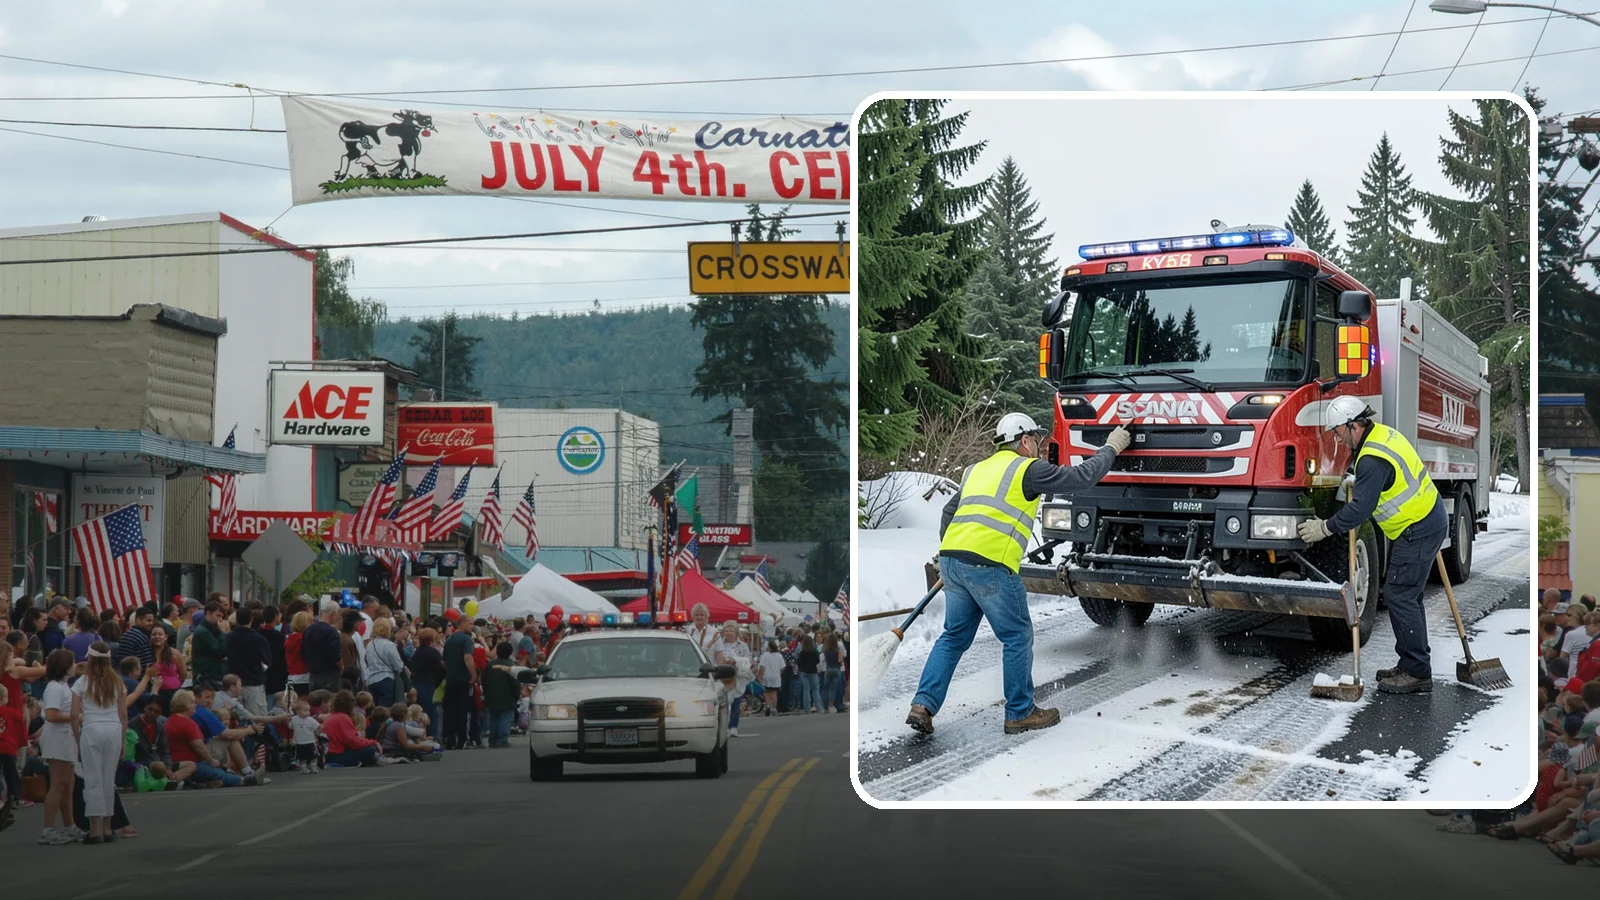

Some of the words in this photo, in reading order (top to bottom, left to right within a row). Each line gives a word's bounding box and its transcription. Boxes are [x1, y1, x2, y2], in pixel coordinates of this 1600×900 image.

[481, 141, 604, 192] JULY
[632, 149, 746, 197] 4th.
[697, 254, 850, 280] CROSSWA
[283, 380, 373, 420] ACE
[406, 409, 452, 421] CEDAR
[1116, 400, 1199, 418] SCANIA
[283, 421, 370, 436] Hardware
[353, 467, 386, 482] Simpl
[96, 485, 124, 494] Vincent
[126, 486, 136, 495] de
[138, 486, 155, 495] Paul
[81, 503, 153, 522] THT
[688, 526, 742, 535] CRNATION
[699, 535, 730, 543] GLASS
